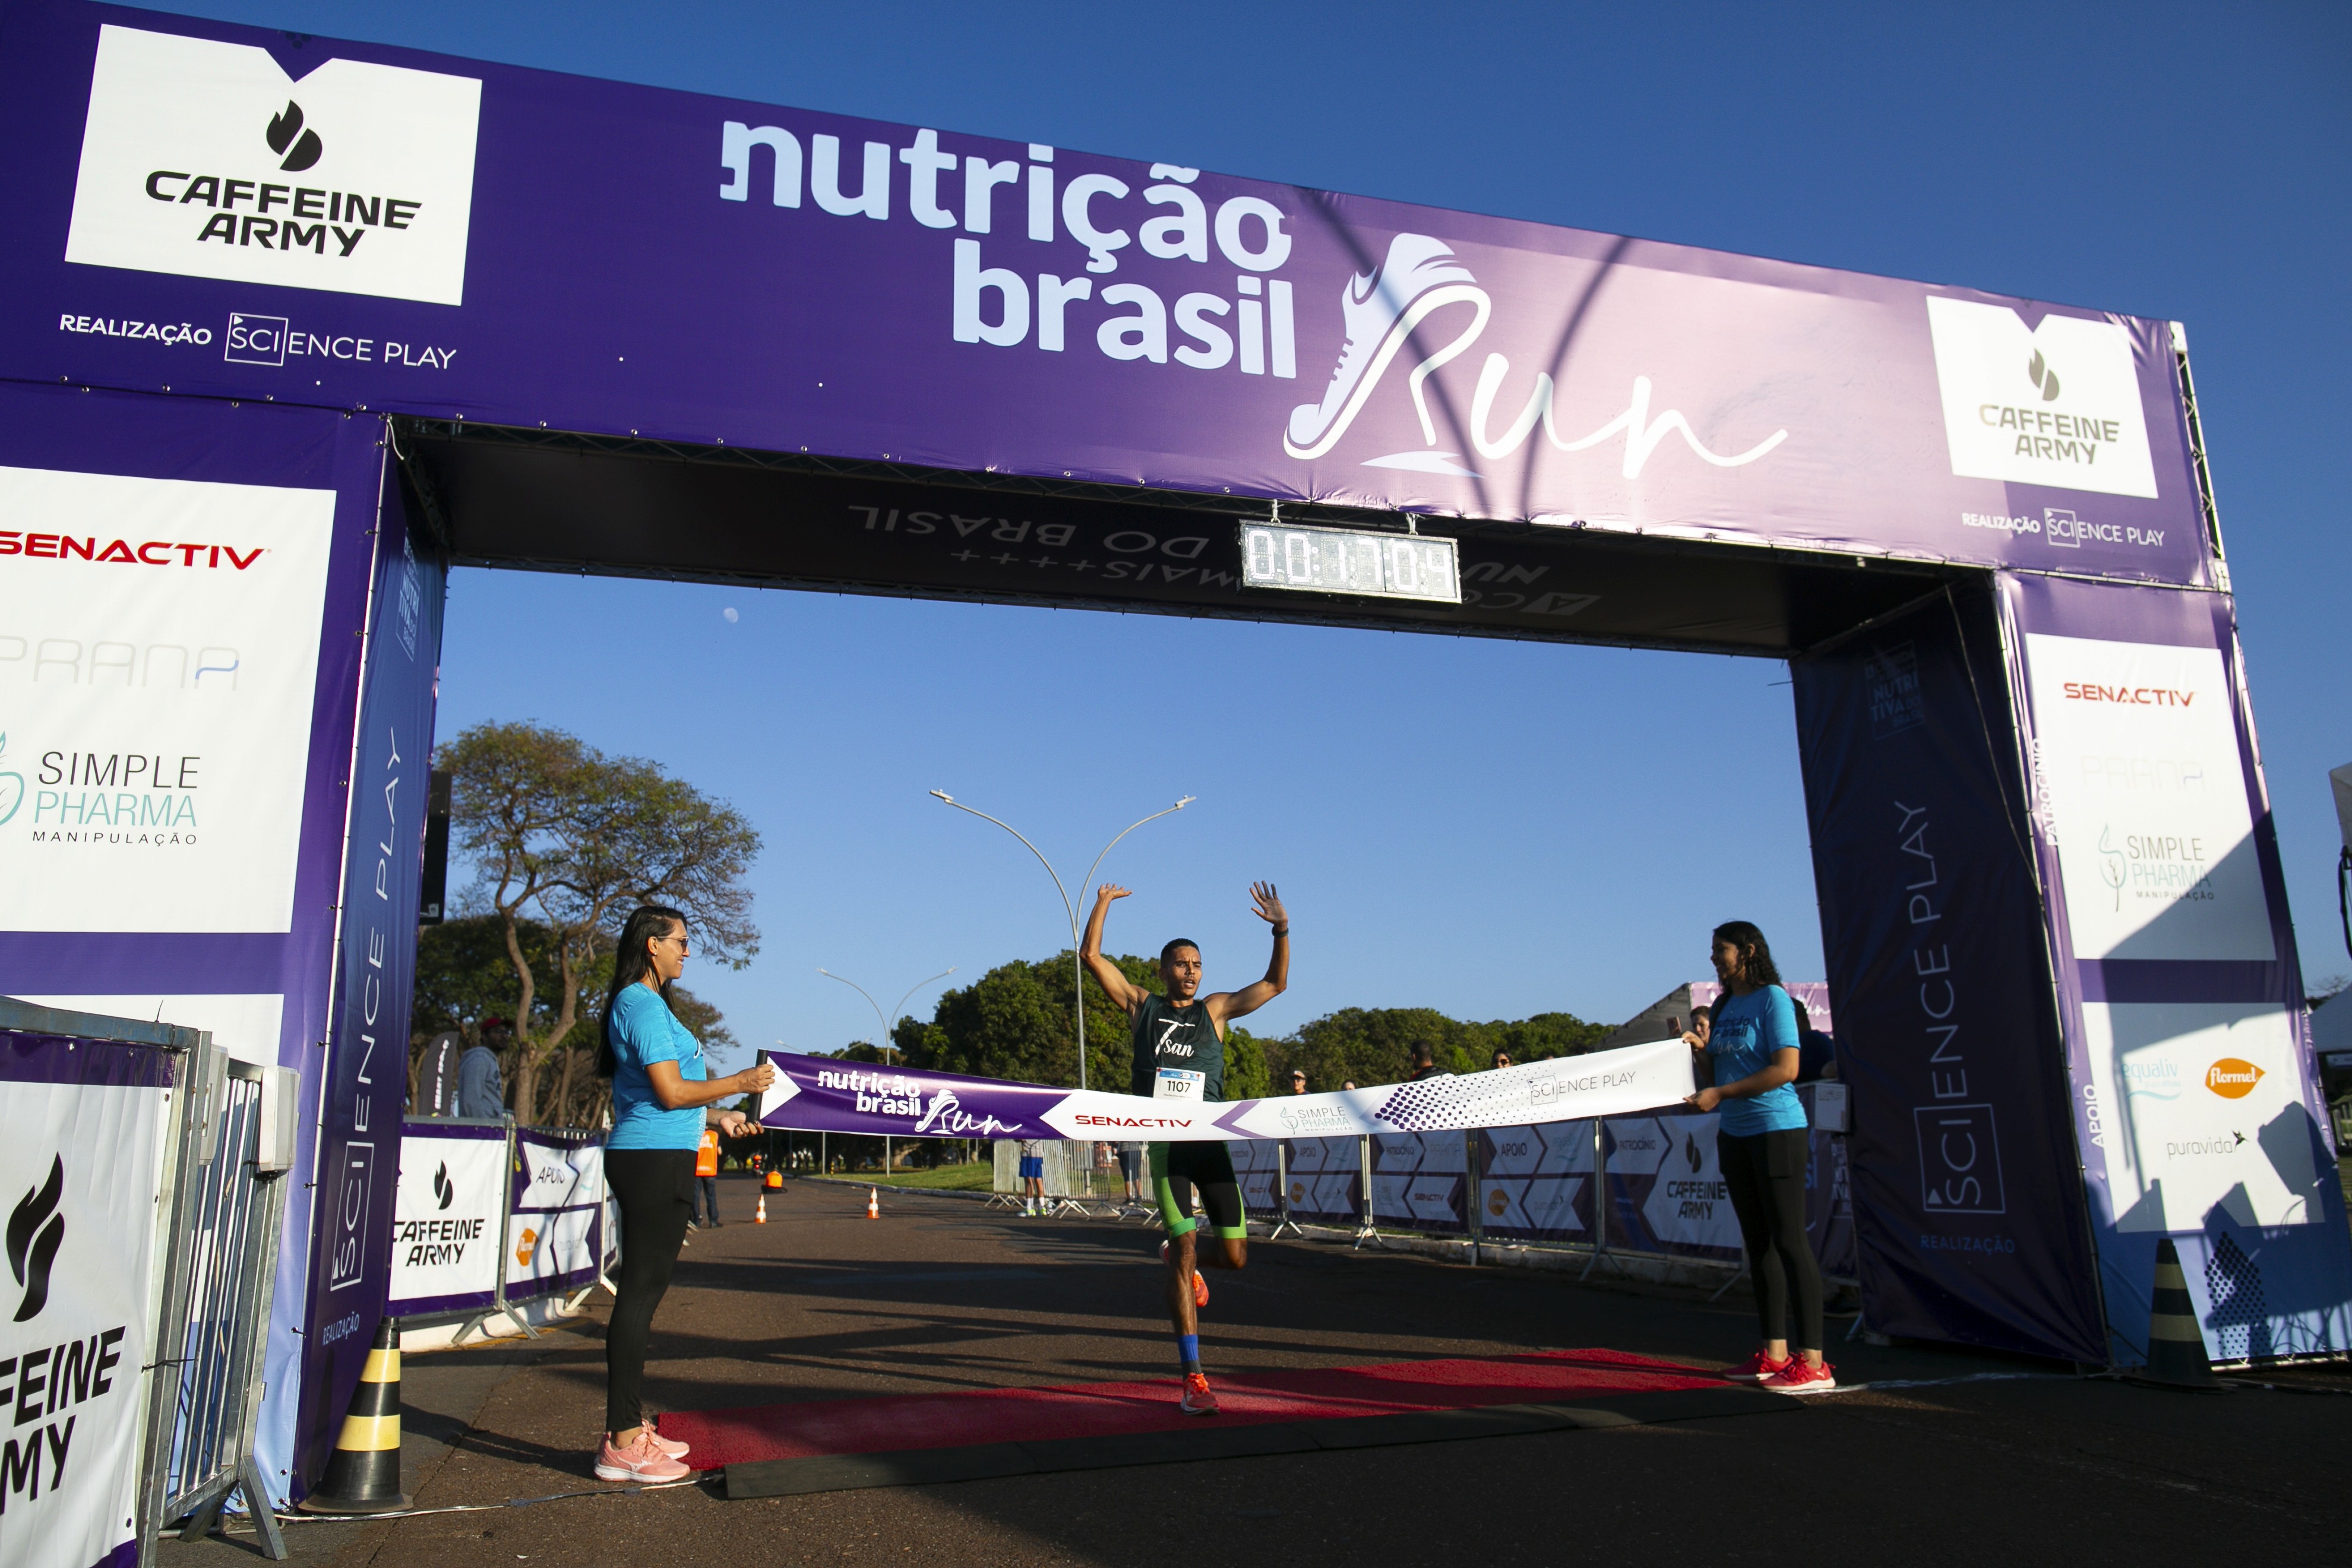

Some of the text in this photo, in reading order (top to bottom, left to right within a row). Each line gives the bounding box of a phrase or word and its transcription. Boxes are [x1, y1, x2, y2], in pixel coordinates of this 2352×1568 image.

[145, 170, 422, 230] CAFFEINE
[719, 120, 1292, 273] nutrição
[197, 213, 365, 257] ARMY
[953, 238, 1297, 378] brasil
[59, 314, 457, 369] REALIZAÇÃO SCIENCE PLAY
[1283, 285, 1788, 479] Run
[1979, 404, 2120, 442] CAFFEINE
[2015, 435, 2097, 464] ARMY
[848, 505, 1210, 559] DO BRASIL
[1961, 512, 2165, 546] REALIZAÇÃO SCIENCE PLAY
[2064, 682, 2194, 707] SENACTIV
[38, 751, 201, 789] SIMPLE
[34, 791, 197, 827] PHARMA
[33, 831, 197, 847] MANIPULAÇÃO
[2127, 835, 2205, 861] SIMPLE
[2131, 863, 2211, 888] PHARMA
[340, 726, 400, 1276] SCIENCE PLAY
[1894, 799, 1981, 1206] SCIENCE PLAY
[818, 1068, 921, 1098] nutrição
[1167, 1080, 1191, 1093] 1107
[1532, 1071, 1636, 1098] SCIENCE PLAY
[2210, 1066, 2256, 1088] flormel
[856, 1092, 921, 1116] brasil
[915, 1097, 1022, 1135] Run
[1298, 1106, 1346, 1119] SIMPLE
[2083, 1084, 2103, 1149] APOIO
[1075, 1114, 1193, 1128] SENACTIV
[1301, 1117, 1351, 1128] PHARMA
[1501, 1143, 1527, 1156] APOIO
[2167, 1136, 2233, 1161] puravida
[1677, 1201, 1713, 1221] ARMY
[406, 1243, 465, 1267] ARMY
[1920, 1235, 2015, 1256] REALIZAÇÃO
[322, 1310, 360, 1346] REALIZAÇÃO
